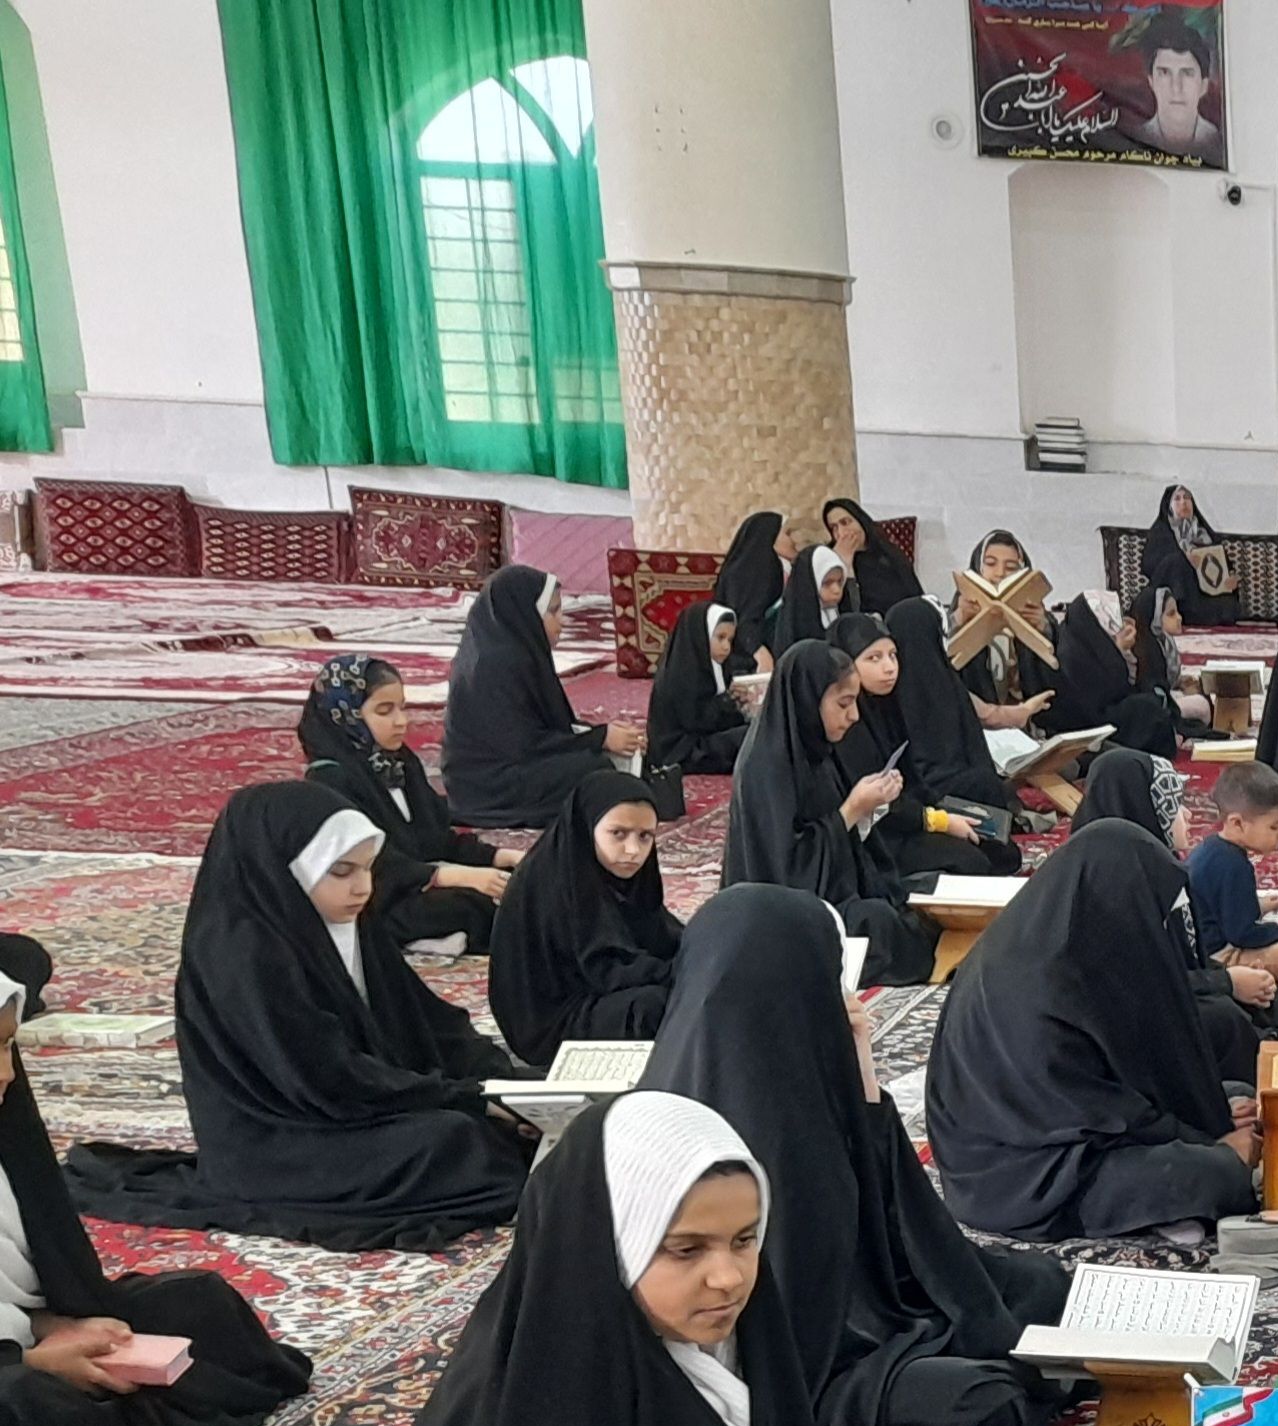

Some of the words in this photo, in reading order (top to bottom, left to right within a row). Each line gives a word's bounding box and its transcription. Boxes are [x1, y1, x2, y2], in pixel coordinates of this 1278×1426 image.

[1082, 149, 1117, 162] مرحوم
[1119, 149, 1151, 162] ناکام
[1153, 153, 1180, 166] جوان
